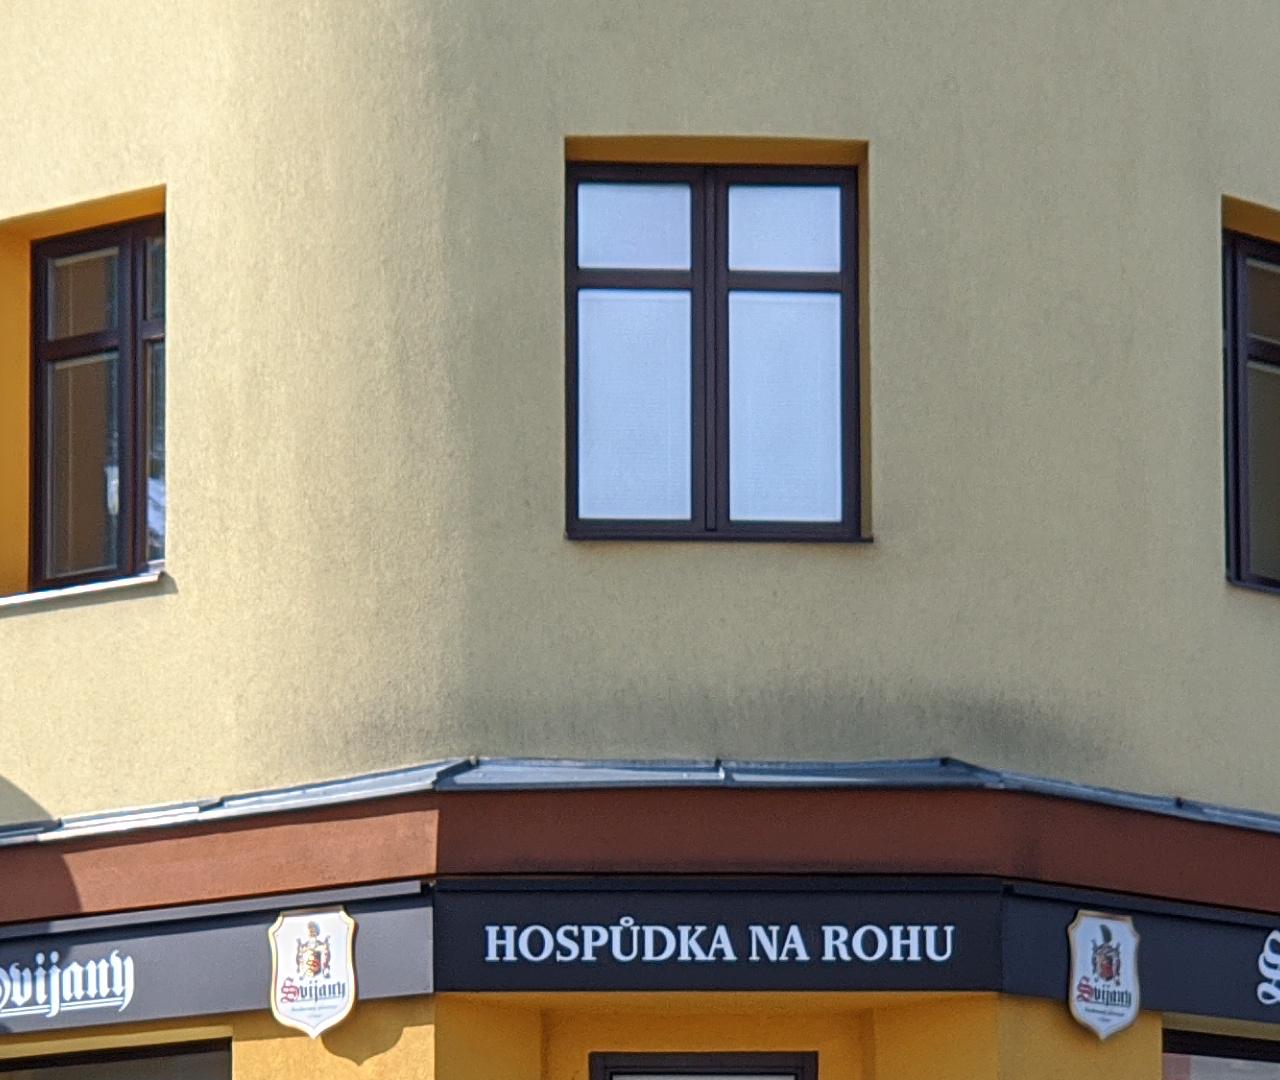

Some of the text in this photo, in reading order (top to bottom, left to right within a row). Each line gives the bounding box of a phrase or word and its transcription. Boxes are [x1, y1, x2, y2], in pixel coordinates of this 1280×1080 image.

[484, 916, 955, 963] HOSPŮDKA NA ROHU
[280, 976, 346, 1004] Svijany
[1077, 975, 1132, 1008] Svijany
